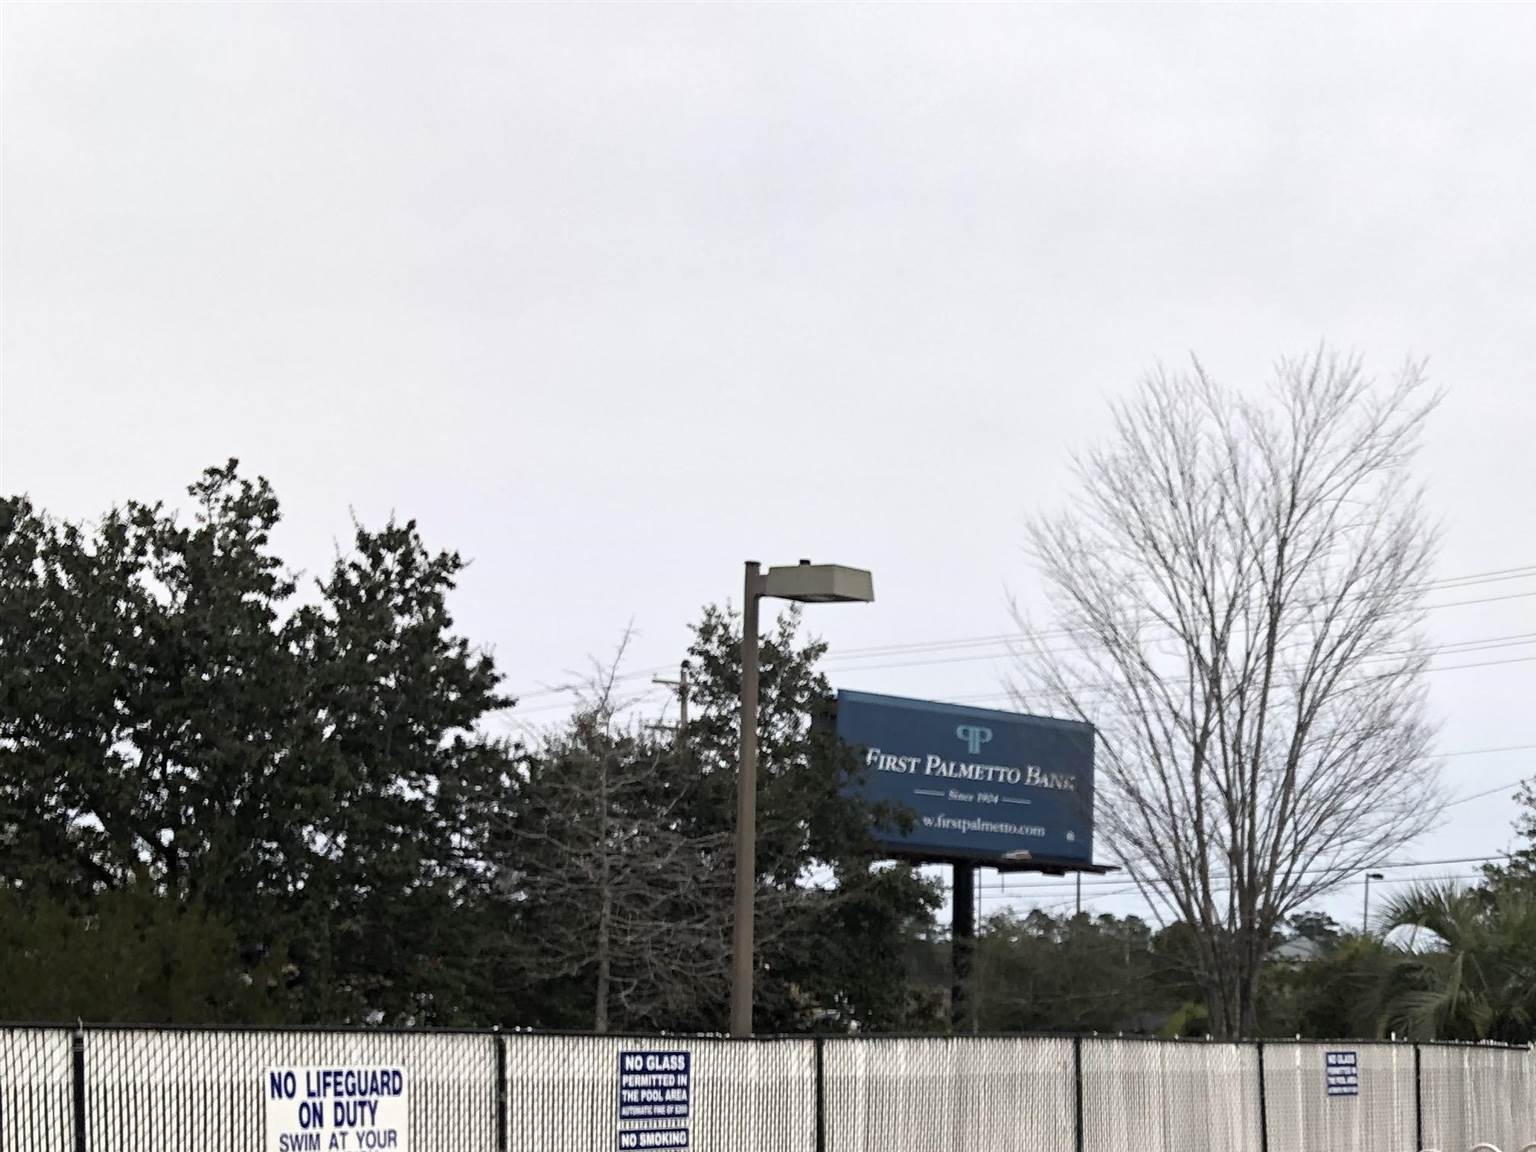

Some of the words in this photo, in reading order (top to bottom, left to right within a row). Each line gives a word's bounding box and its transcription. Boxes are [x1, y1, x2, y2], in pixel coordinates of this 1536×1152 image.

[925, 754, 1021, 784] PALMETTO
[923, 813, 1046, 838] w.firstpalmetto.com
[625, 1055, 643, 1071] NO
[646, 1055, 685, 1071] GLASS
[270, 1071, 296, 1099] NO
[306, 1070, 403, 1098] LIFEGUARD
[622, 1074, 675, 1087] PERMITTED
[677, 1074, 688, 1087] IN
[622, 1089, 639, 1102] THE
[640, 1089, 664, 1102] POOL
[665, 1088, 688, 1101] AREA
[299, 1101, 324, 1128] ON
[334, 1100, 378, 1127] DUTY
[329, 1131, 348, 1150] AT
[356, 1129, 397, 1149] YOUR
[621, 1133, 638, 1147] NO
[639, 1131, 687, 1147] SMOKING
